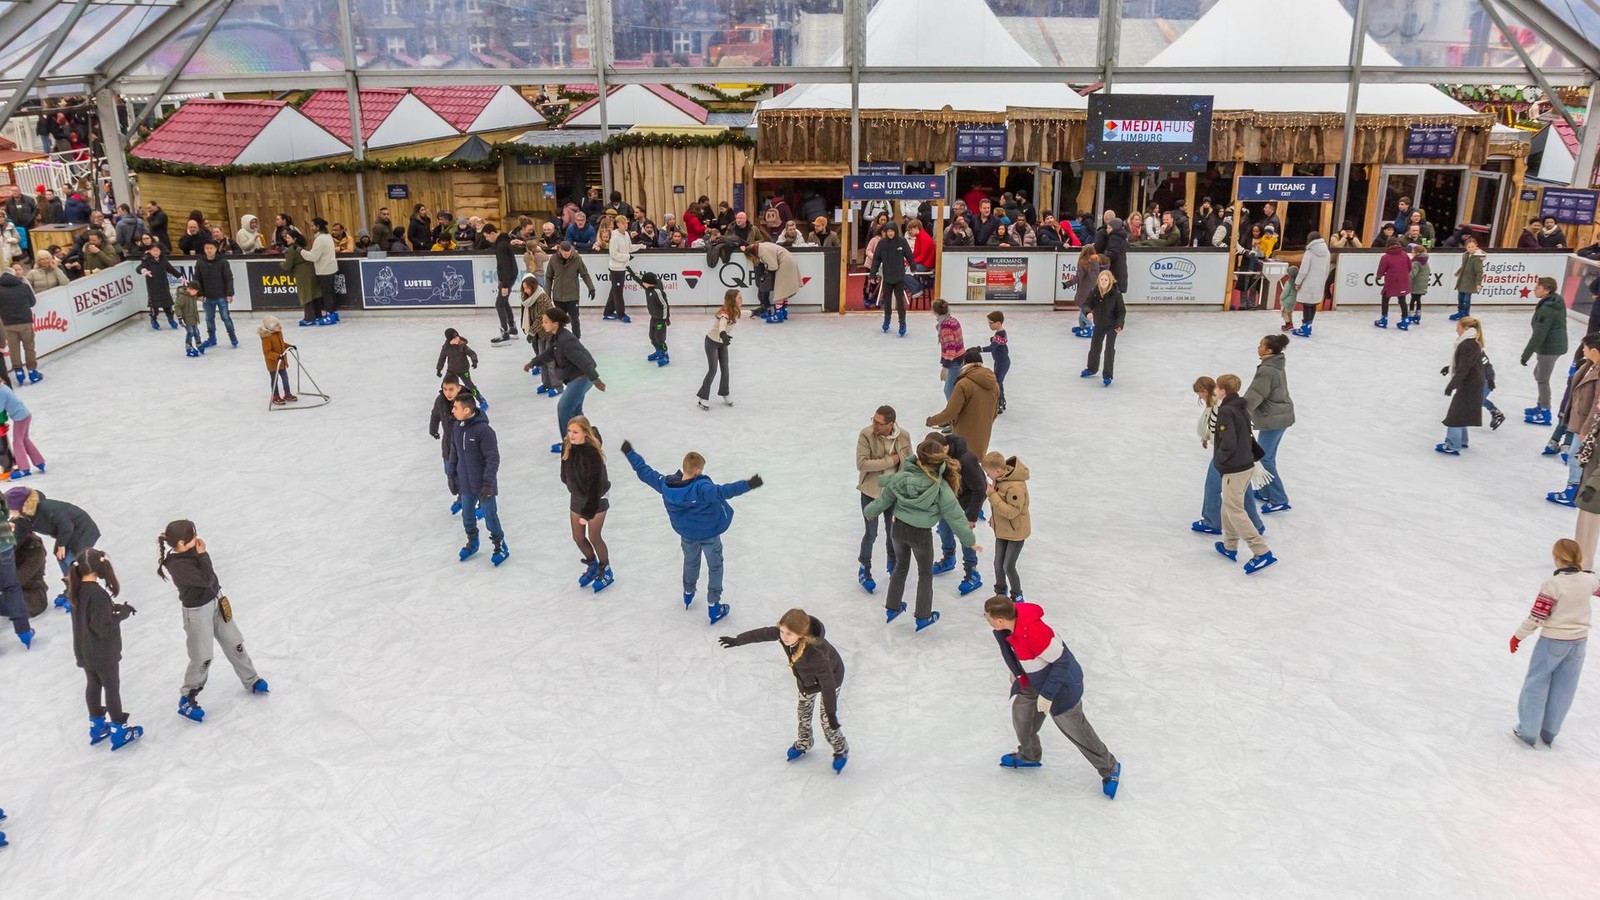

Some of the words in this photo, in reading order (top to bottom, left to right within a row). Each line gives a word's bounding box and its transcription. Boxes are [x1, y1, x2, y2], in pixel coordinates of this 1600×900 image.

[1121, 120, 1194, 133] MEDIAHUIS
[1120, 133, 1163, 142] LIMBURG
[863, 181, 885, 189] GEEN
[887, 181, 926, 190] UITGANG
[1268, 183, 1306, 191] UITGANG
[73, 275, 134, 313] BESSEMS
[263, 286, 273, 294] JE
[273, 286, 287, 294] JAS
[1480, 285, 1519, 298] rijthof
